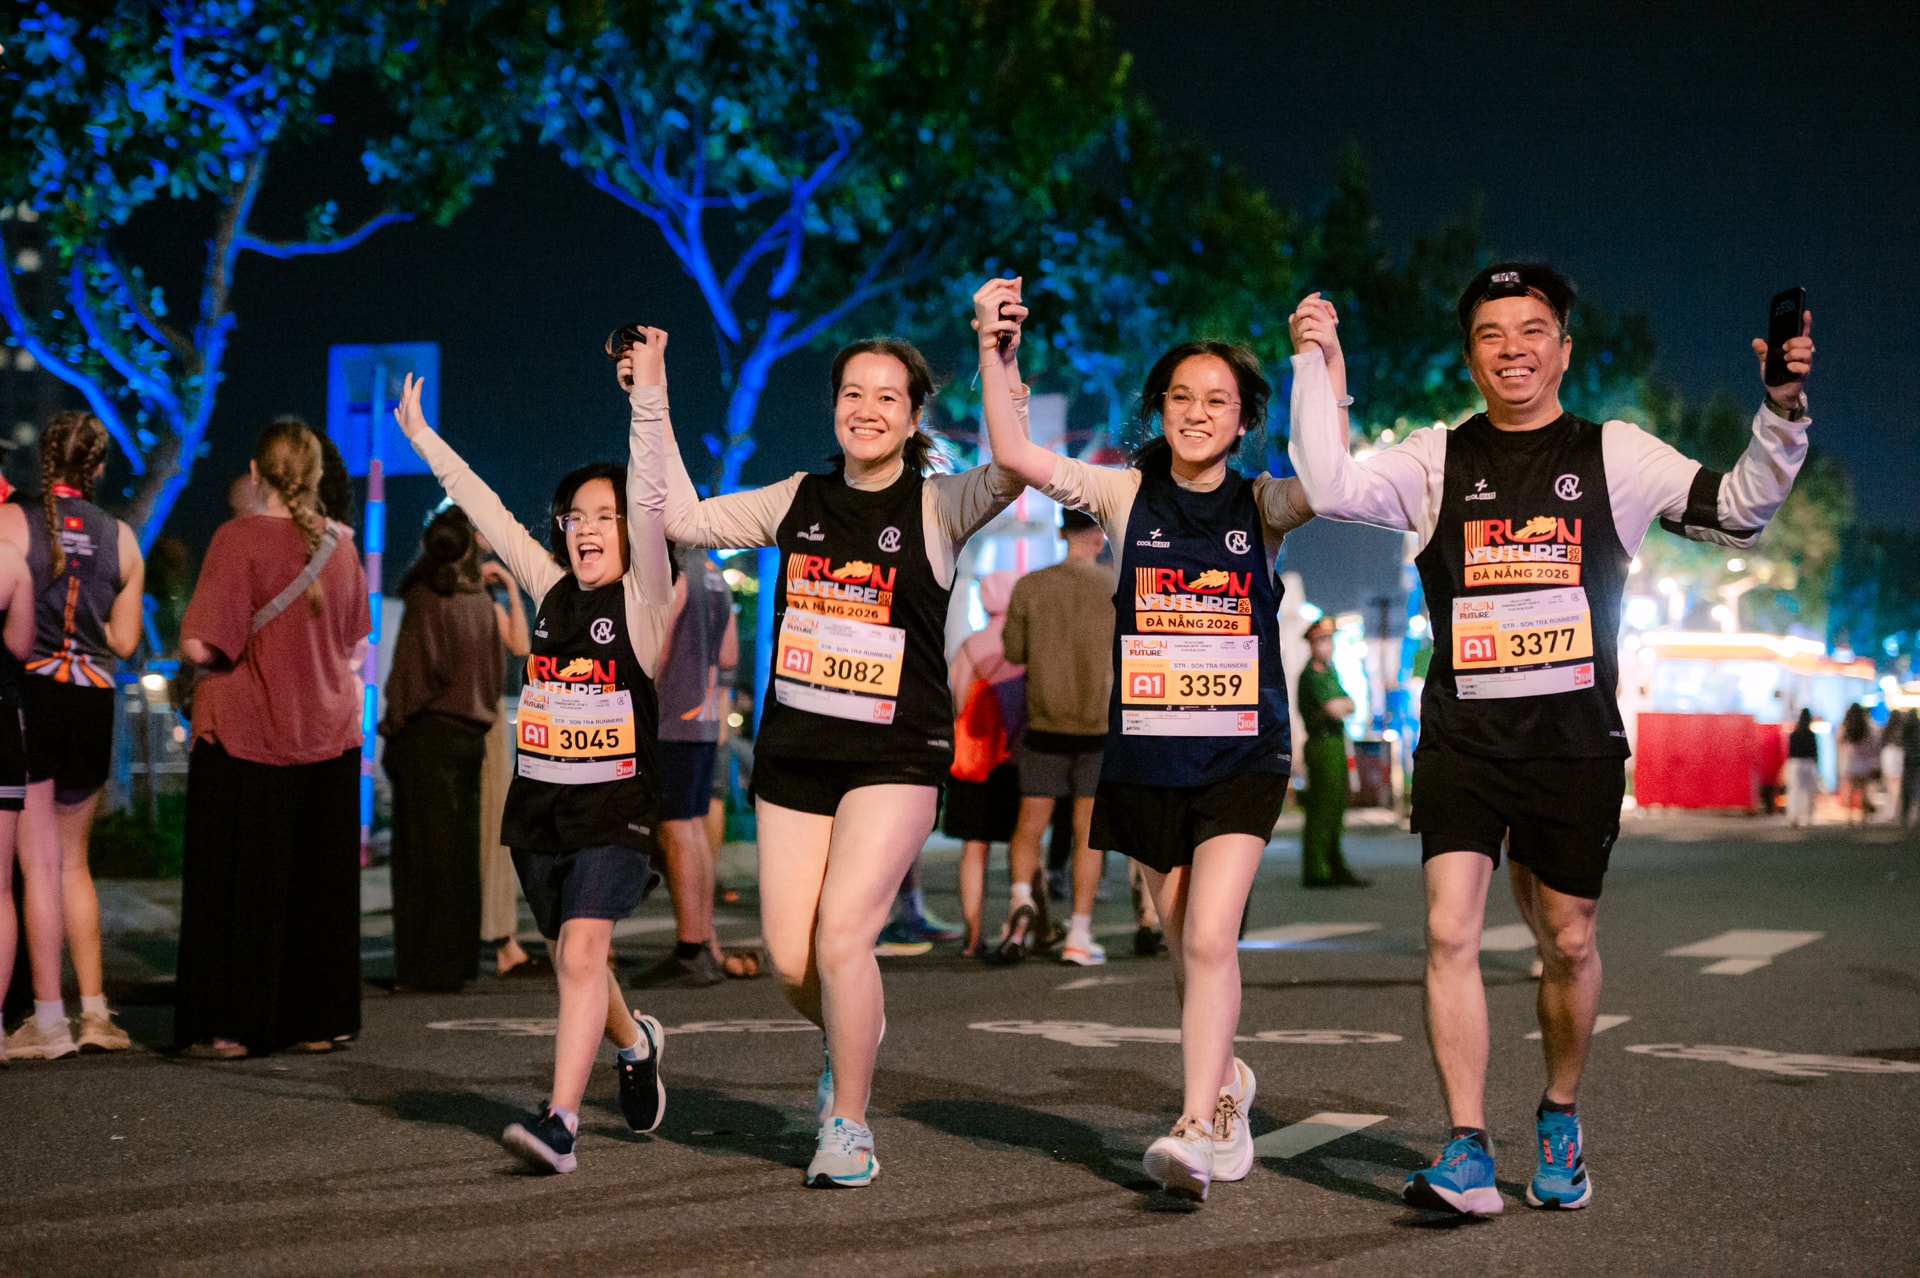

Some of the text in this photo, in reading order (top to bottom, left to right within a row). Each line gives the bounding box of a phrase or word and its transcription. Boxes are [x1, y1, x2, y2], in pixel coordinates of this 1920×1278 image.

[1484, 518, 1582, 545] RUN
[1473, 544, 1566, 564] FUTURE
[802, 554, 896, 592] RUN
[1156, 568, 1252, 596] RUN
[1474, 568, 1490, 580] ĐÀ
[1536, 569, 1569, 579] 2026
[794, 578, 878, 604] FUTURE
[847, 607, 878, 618] 2026
[1146, 594, 1238, 614] FUTURE
[1464, 600, 1494, 612] RUN
[1146, 616, 1164, 628] ĐÀ
[1206, 620, 1238, 630] 2026
[1549, 616, 1580, 625] RUNNERS
[1134, 640, 1168, 649] RUN
[1464, 638, 1492, 659] A1
[1510, 628, 1574, 656] 3377
[535, 655, 616, 683] RUN
[786, 648, 810, 672] A1
[824, 656, 884, 685] 3082
[1134, 676, 1160, 694] A1
[1180, 674, 1242, 697] 3359
[524, 724, 545, 745] A1
[560, 728, 619, 750] 3045
